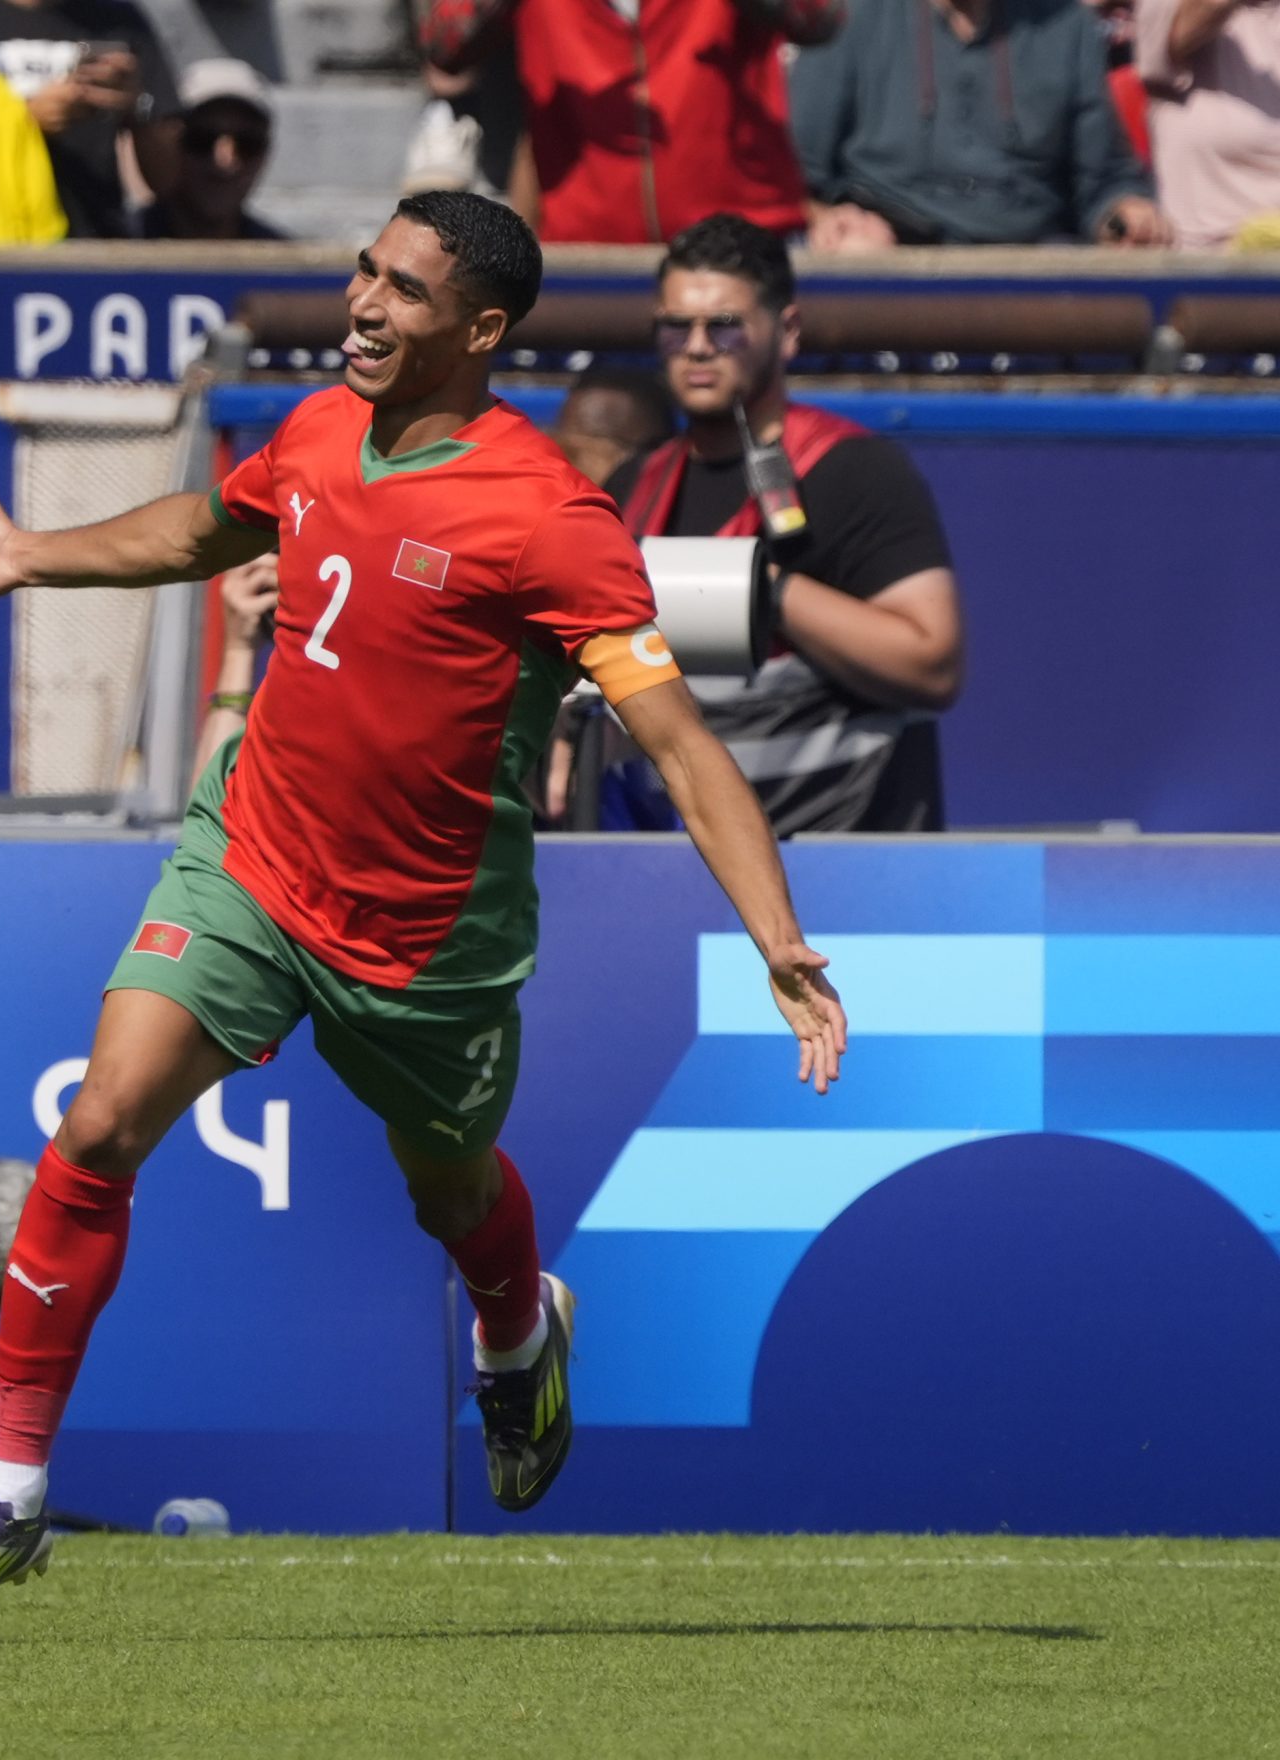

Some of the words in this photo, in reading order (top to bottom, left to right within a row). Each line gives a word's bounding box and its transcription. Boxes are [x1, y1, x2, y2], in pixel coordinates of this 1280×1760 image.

[305, 554, 352, 670] 2
[630, 623, 673, 668] C
[457, 1026, 502, 1111] 2
